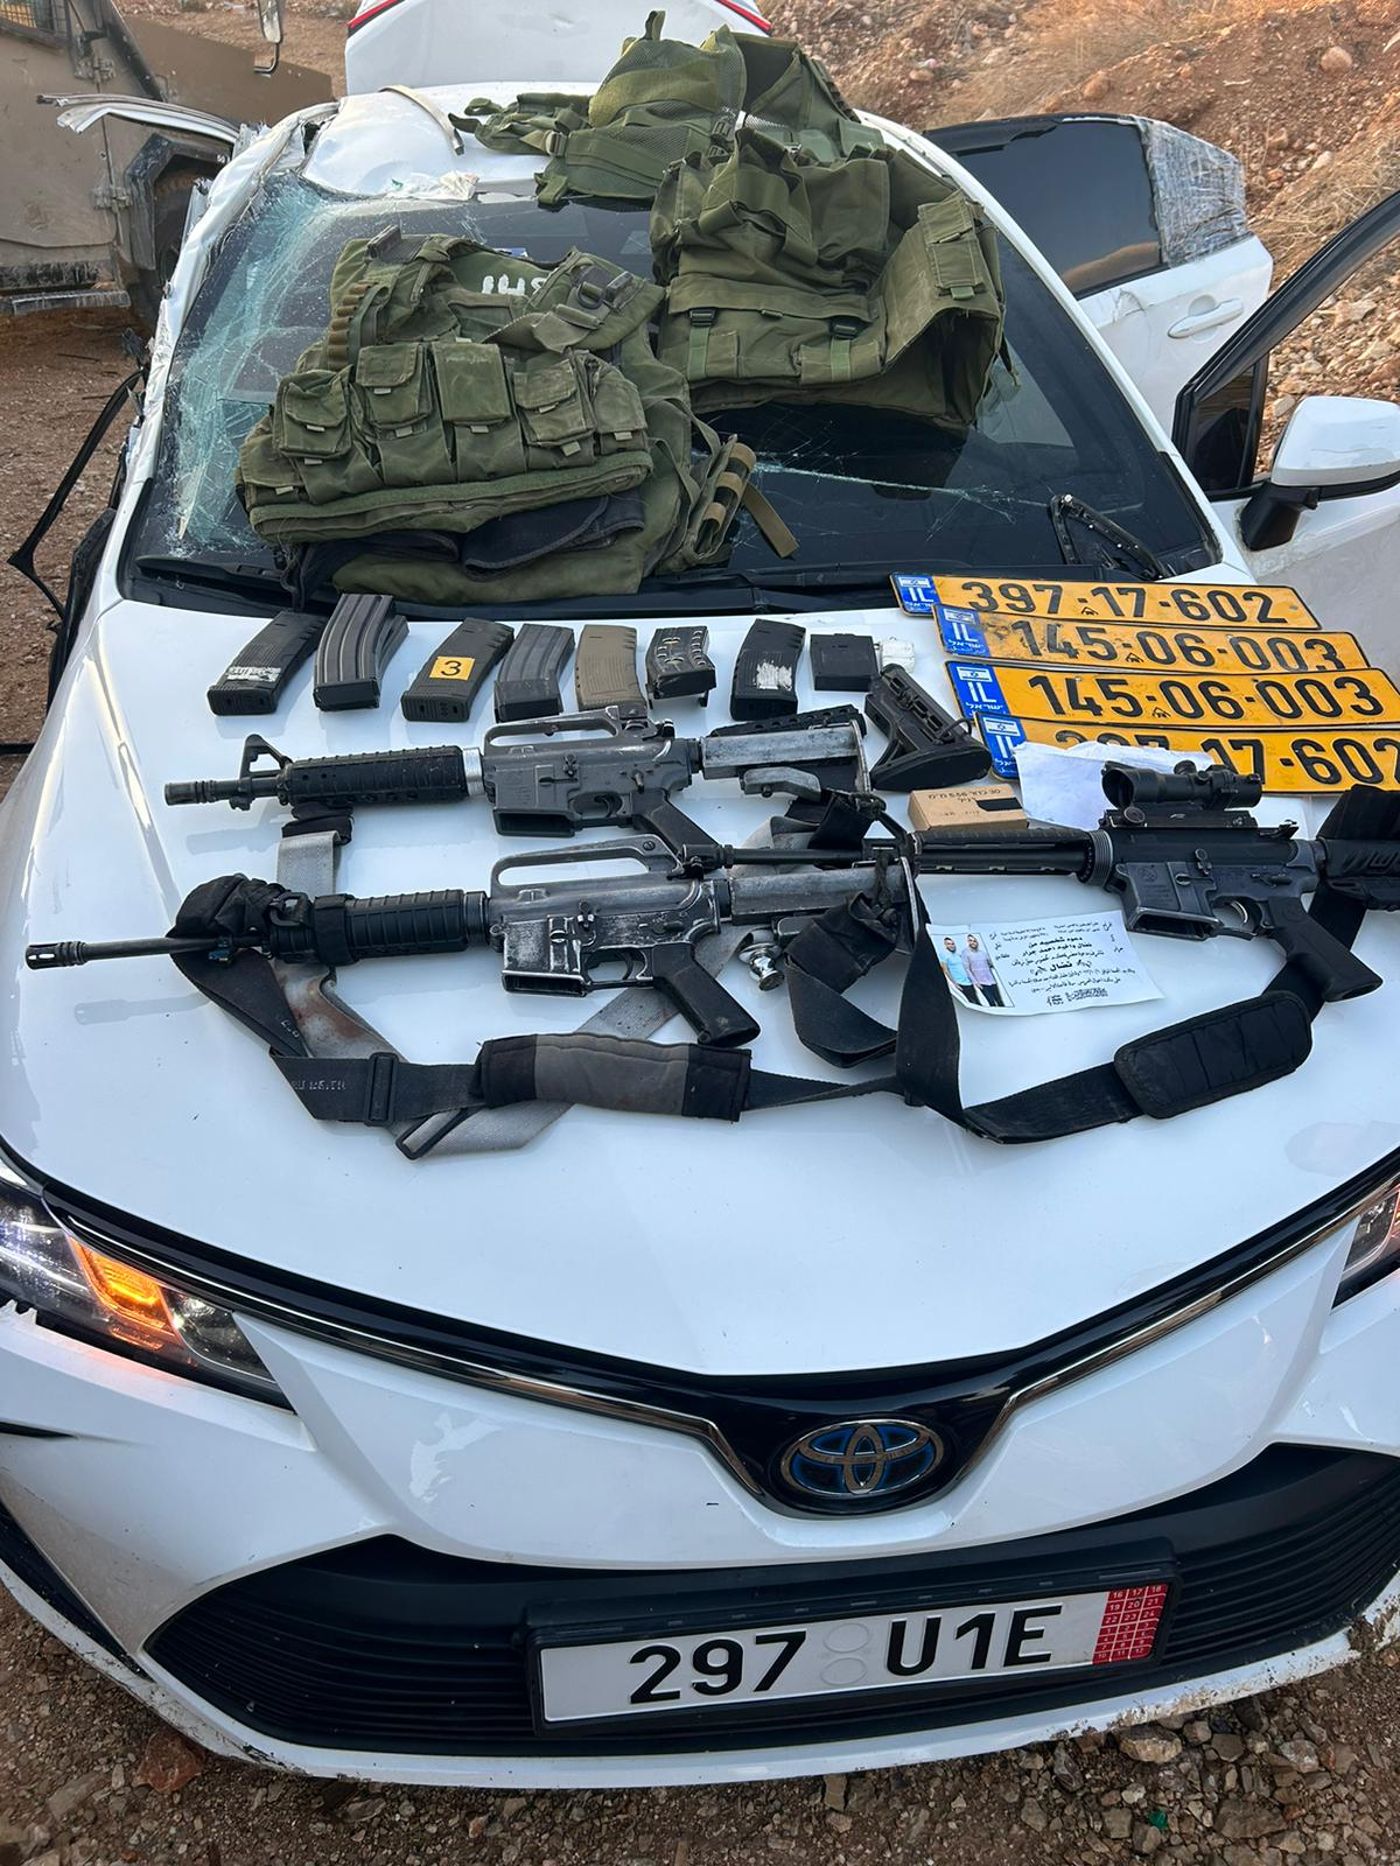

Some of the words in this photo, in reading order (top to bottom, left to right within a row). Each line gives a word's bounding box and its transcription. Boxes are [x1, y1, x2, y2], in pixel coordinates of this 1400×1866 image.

[908, 587, 934, 602] IL
[961, 581, 1288, 624] 397-17-602
[952, 622, 979, 642] IL
[1010, 620, 1346, 672] 145-06-003
[441, 660, 462, 676] 3
[967, 682, 997, 702] IL
[1028, 675, 1384, 719] 145-06-003
[1055, 730, 1400, 785] 17-602
[1127, 1600, 1140, 1609] 20
[1147, 1598, 1158, 1606] 21
[629, 1630, 807, 1704] 297
[886, 1605, 1064, 1677] U1E
